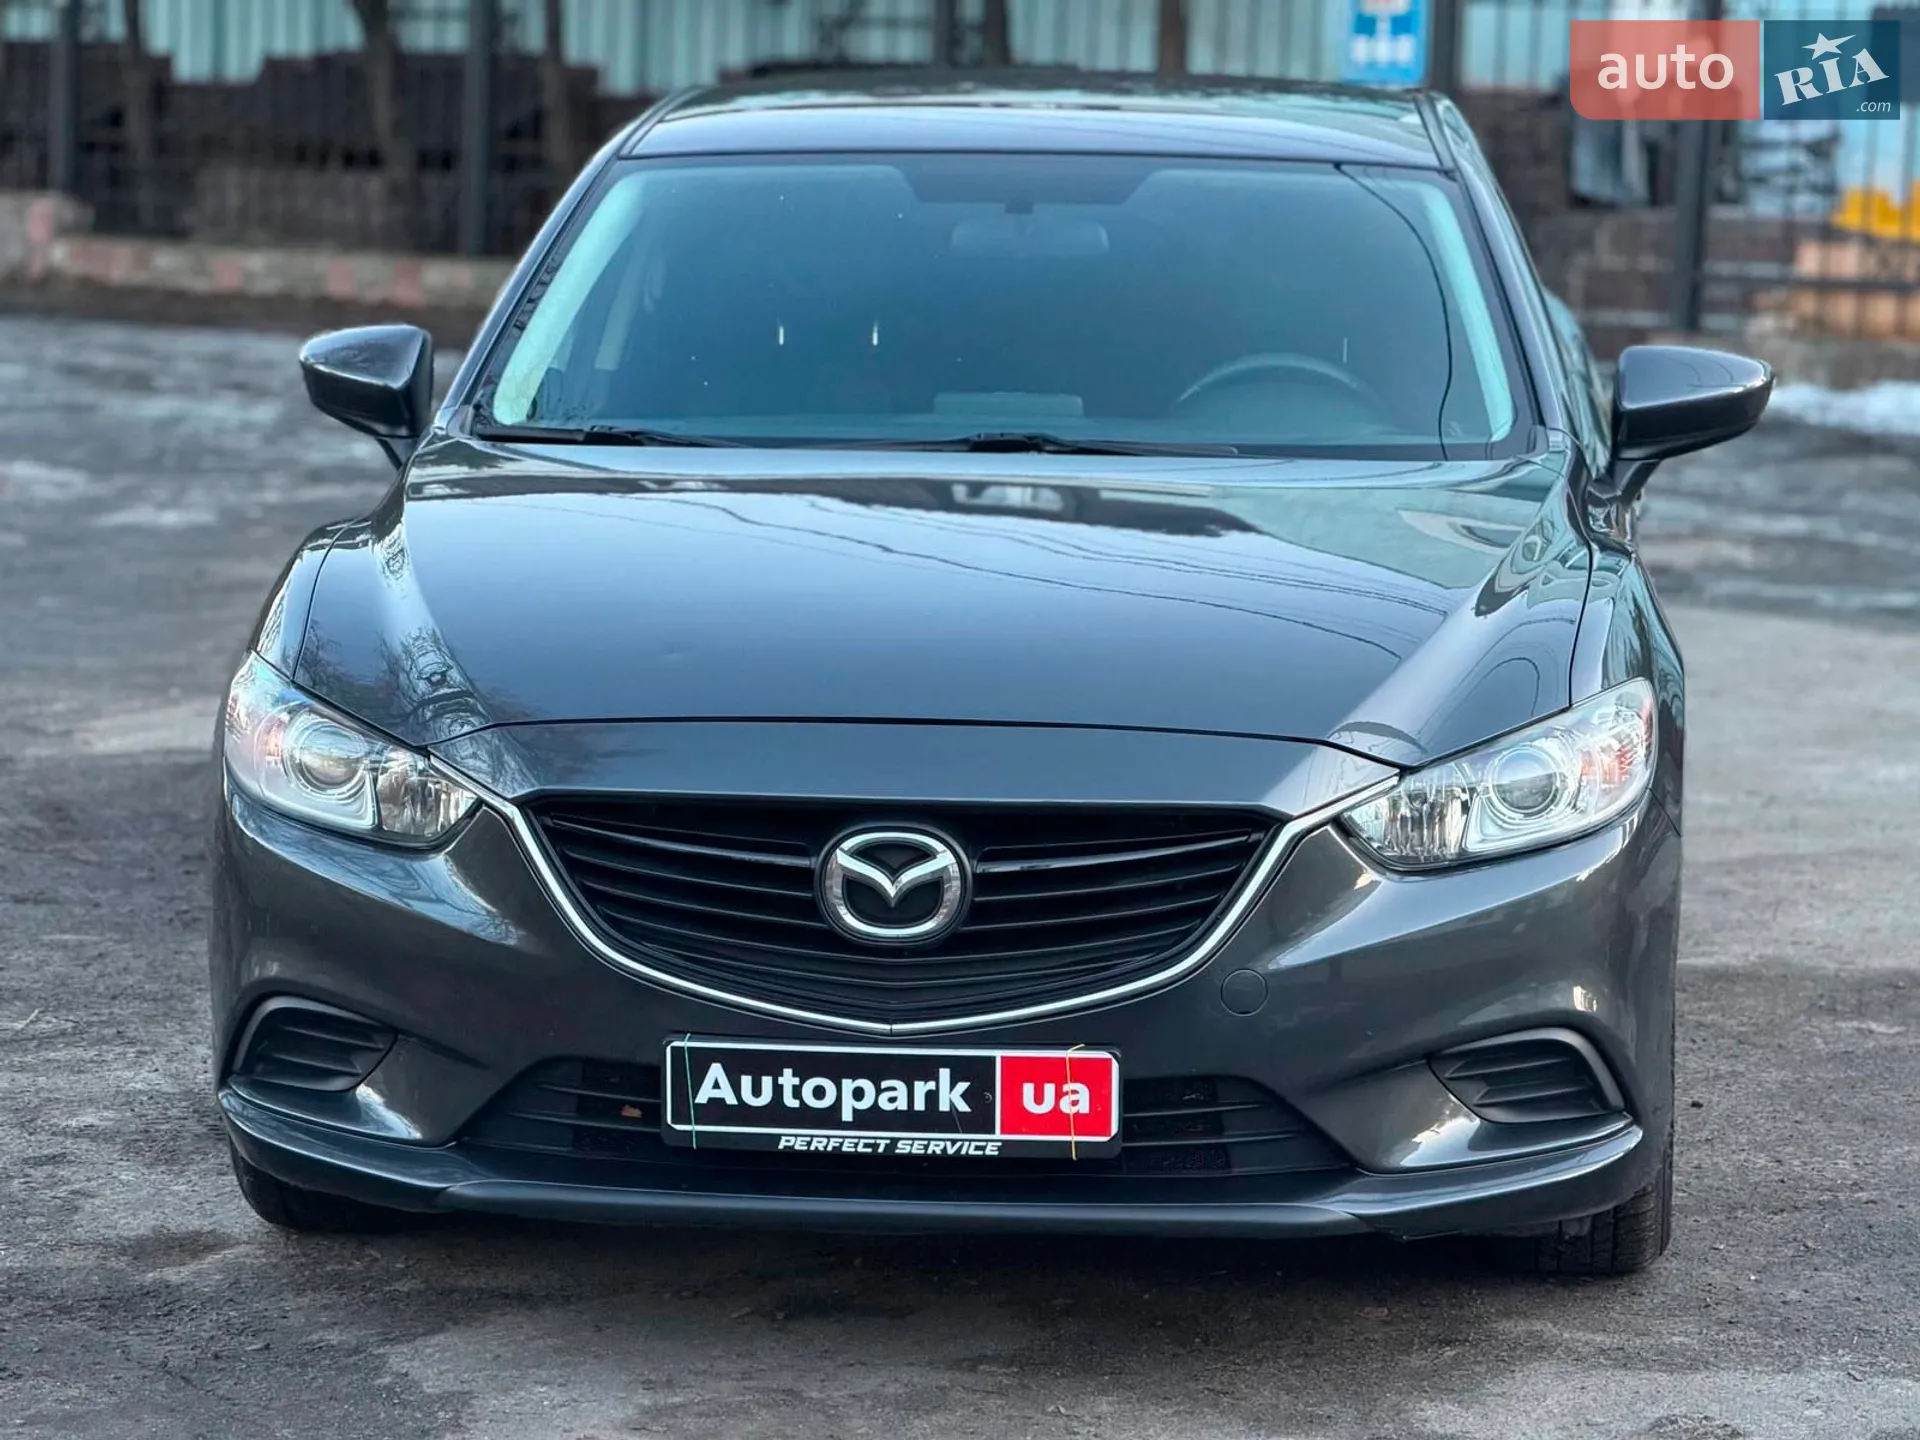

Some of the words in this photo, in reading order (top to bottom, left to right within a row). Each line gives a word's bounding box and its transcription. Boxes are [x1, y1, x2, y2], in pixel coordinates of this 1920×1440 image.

[694, 1062, 972, 1122] Autopark
[1022, 1081, 1091, 1115] ua
[778, 1135, 890, 1154] PERFECT
[894, 1138, 1002, 1156] SERVICE
